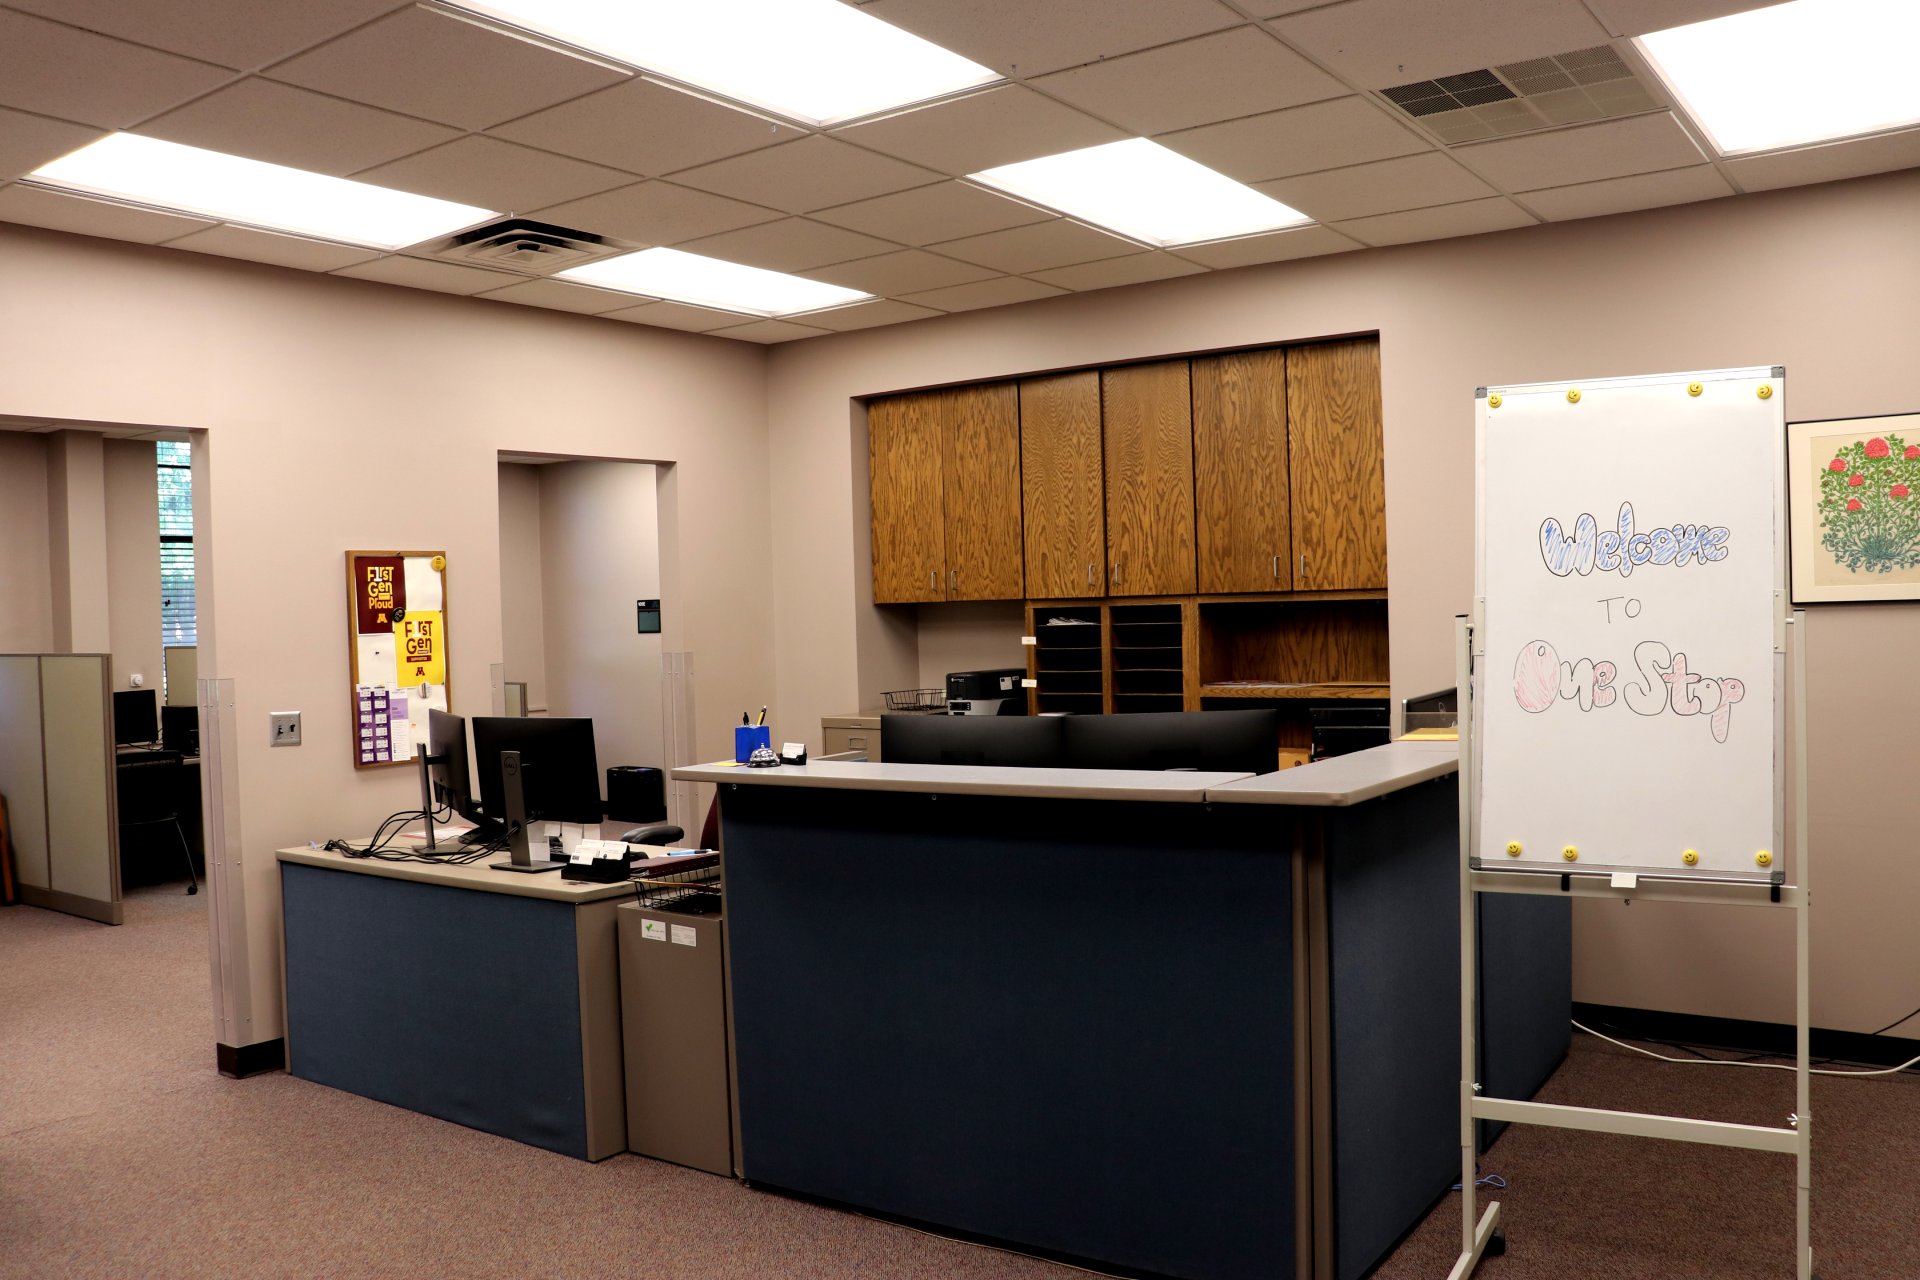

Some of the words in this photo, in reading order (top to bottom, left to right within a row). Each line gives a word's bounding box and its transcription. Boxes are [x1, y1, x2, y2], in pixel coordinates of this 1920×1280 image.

[1539, 501, 1730, 578] Welcome
[368, 582, 393, 597] Gen
[1597, 596, 1641, 624] TO
[406, 637, 432, 654] Gen
[1513, 639, 1617, 713] One
[1623, 640, 1745, 744] Stop
